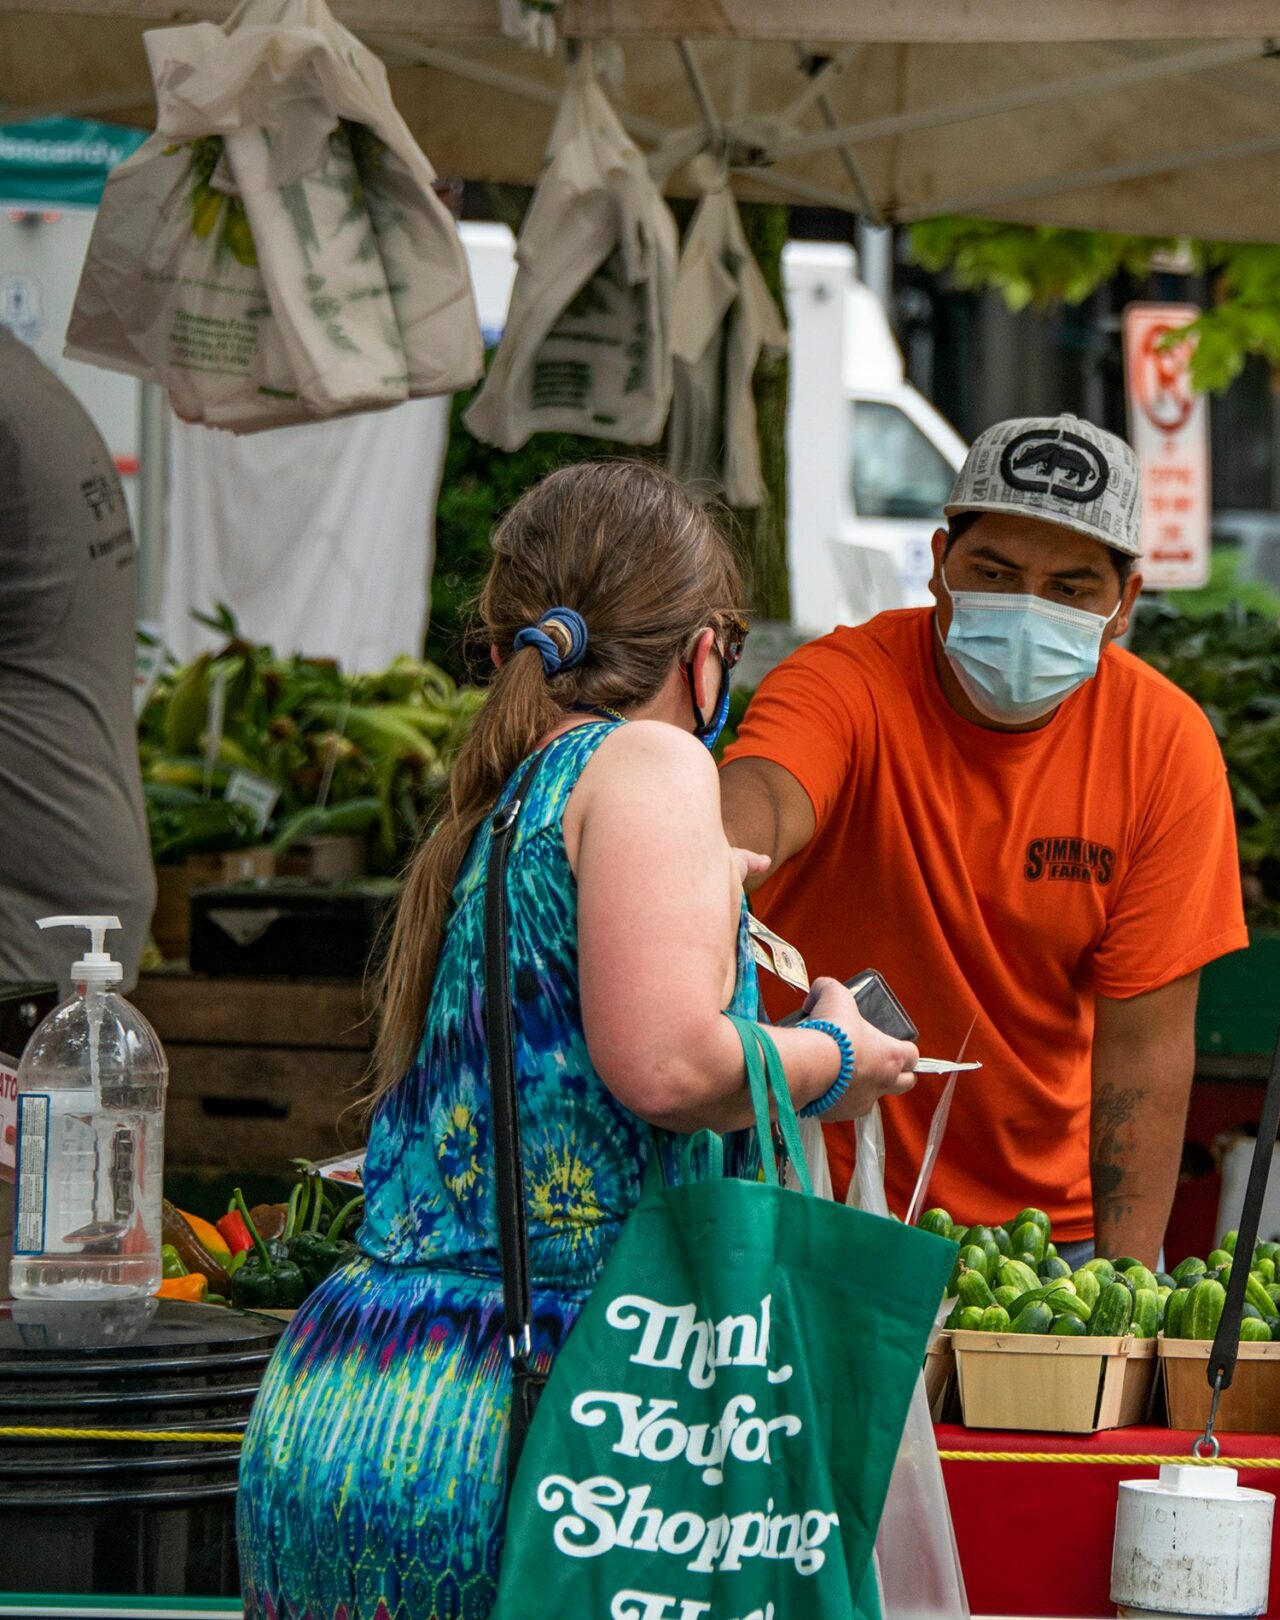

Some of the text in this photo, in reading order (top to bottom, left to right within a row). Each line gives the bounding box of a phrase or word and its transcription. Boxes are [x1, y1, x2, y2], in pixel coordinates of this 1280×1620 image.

[606, 1294, 793, 1389] Thn
[571, 1391, 802, 1486] You for
[537, 1474, 840, 1576] Shopping
